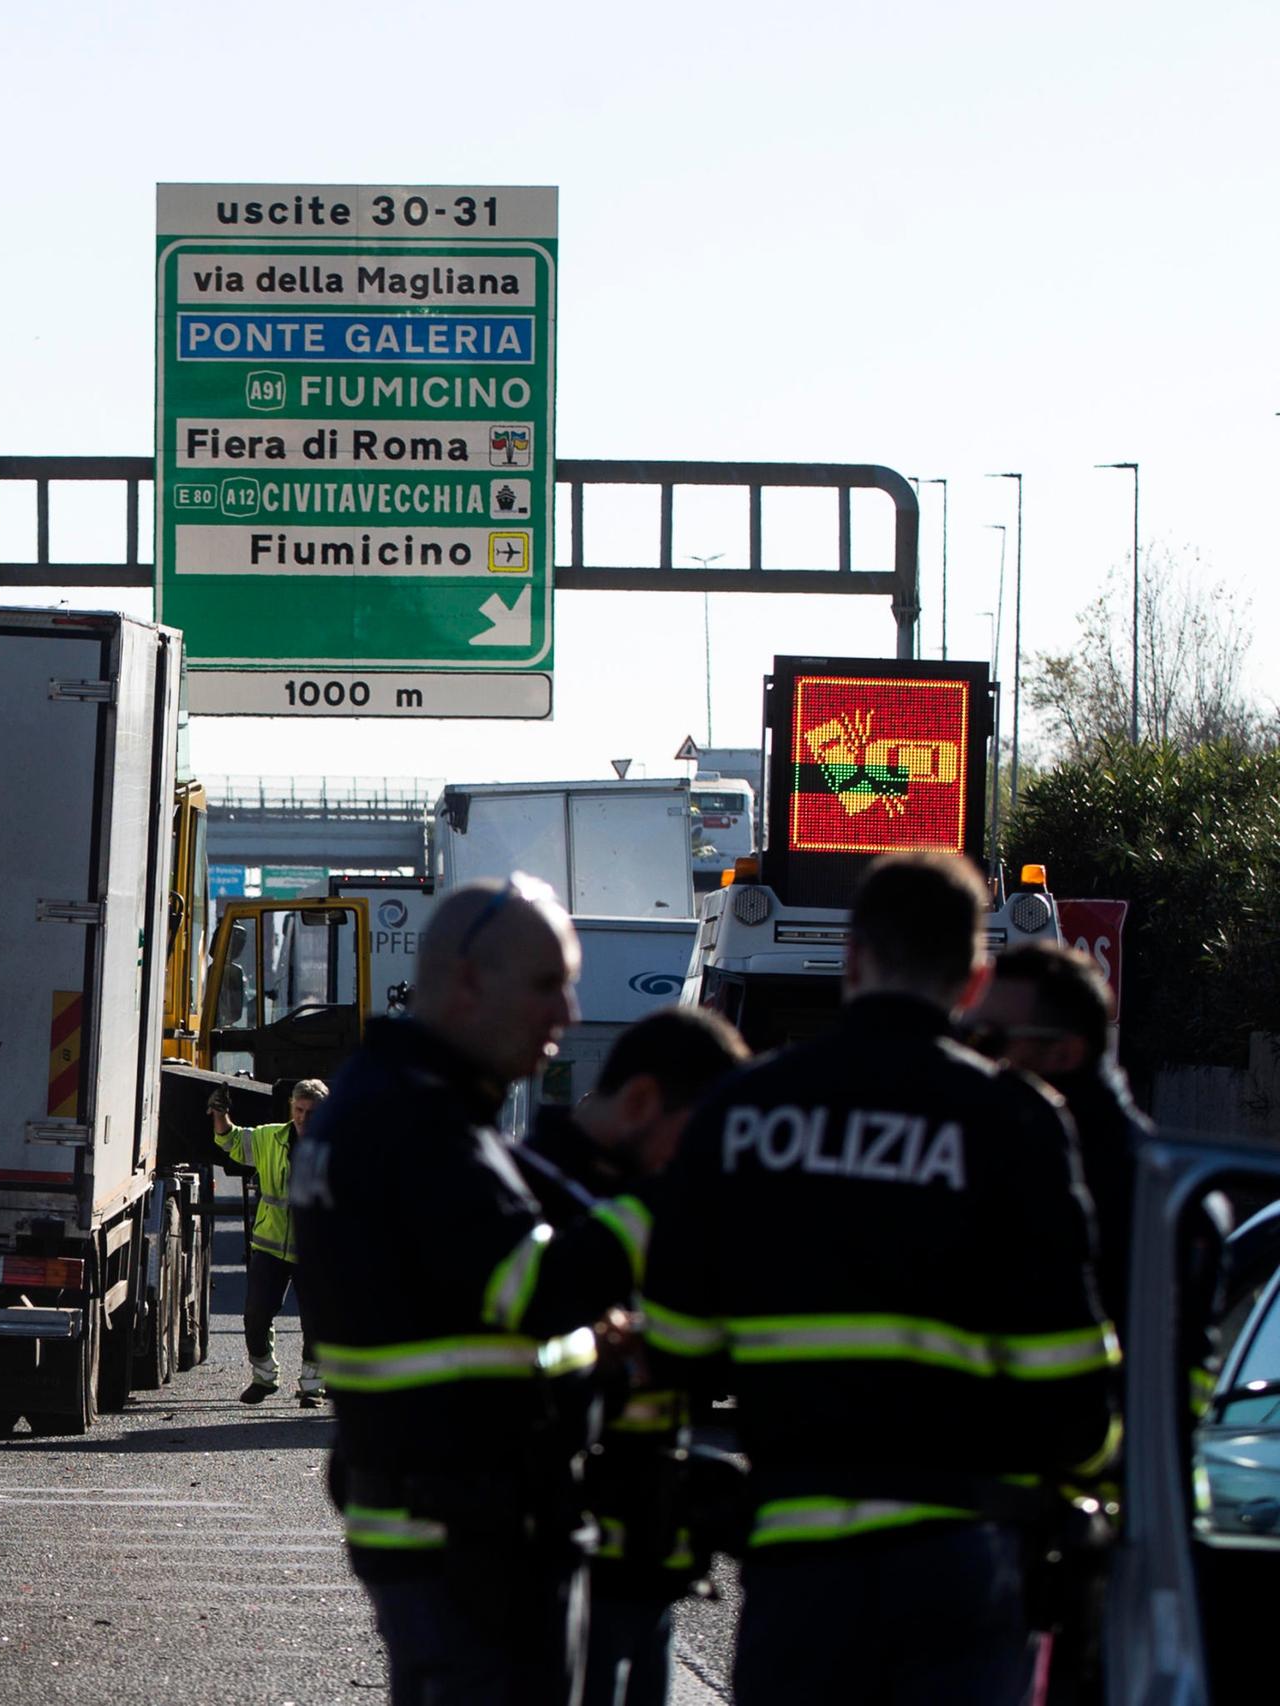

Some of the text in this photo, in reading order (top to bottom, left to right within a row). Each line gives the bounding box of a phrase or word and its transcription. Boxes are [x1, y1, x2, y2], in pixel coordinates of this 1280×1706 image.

[218, 196, 497, 226] uscite 30-31
[194, 266, 519, 300] via della Magliana
[189, 323, 522, 353] PONTE GALERIA
[251, 376, 531, 408] A91 FIUMICINO
[187, 429, 468, 460] Fiera di Roma
[262, 483, 484, 514] CIVITAVECCHIA
[251, 534, 471, 565] Fiumicino
[285, 681, 423, 707] 1000 m
[723, 1105, 967, 1190] POLIZIA
